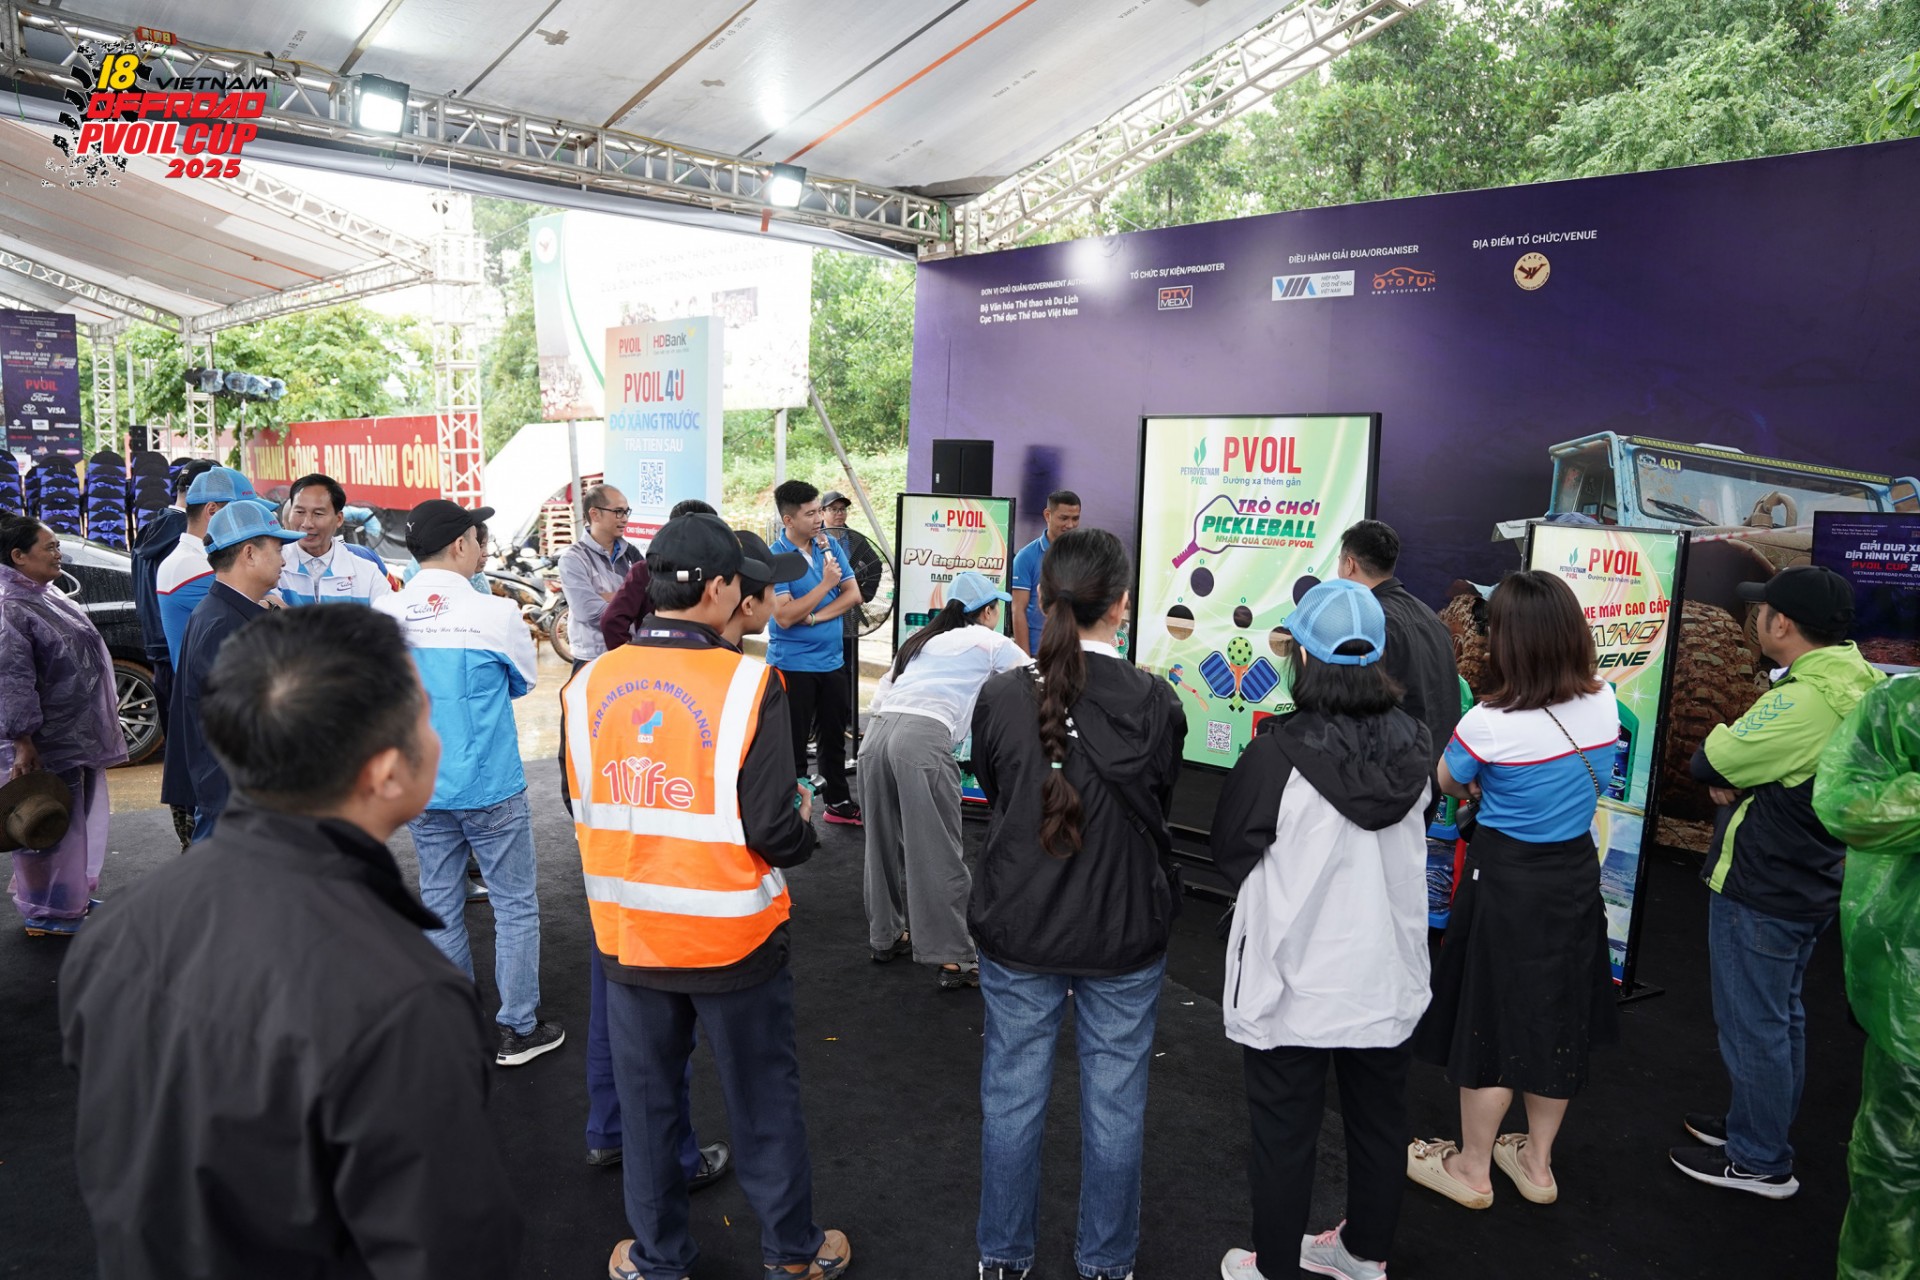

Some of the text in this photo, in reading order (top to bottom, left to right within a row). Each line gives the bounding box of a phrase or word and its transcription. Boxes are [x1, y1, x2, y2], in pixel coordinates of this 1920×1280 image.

[1472, 230, 1598, 250] ĐỊA ĐIỂM TỔ CHỨC/VENUE
[1308, 251, 1331, 262] HÀNH
[1332, 248, 1349, 260] GIẢI
[1350, 244, 1419, 258] ĐUA/ORGANISER
[1170, 262, 1225, 276] KIỆN/PROMOTER
[980, 304, 989, 314] Bộ
[1028, 298, 1044, 308] thao
[1054, 296, 1063, 305] Du
[1064, 294, 1079, 306] Lịch
[1160, 298, 1190, 308] MEDIA
[1032, 310, 1047, 319] thao
[1062, 307, 1079, 317] Nam
[619, 337, 642, 353] PVOIL
[653, 333, 687, 348] HDBank
[26, 380, 58, 392] PVOIL
[30, 392, 55, 403] Ford
[46, 406, 66, 415] VISA
[254, 440, 287, 480] THÀNH
[348, 436, 399, 487] THÀNH
[1223, 436, 1302, 474] PVOIL
[1180, 466, 1220, 476] PETROVIETNAM
[1660, 457, 1681, 471] 407
[1190, 476, 1208, 485] PVOIL
[1222, 476, 1250, 486] Đường
[1286, 477, 1302, 488] gần
[1238, 496, 1321, 516] TRÒ CHƠI
[946, 510, 986, 528] PVOIL
[1202, 515, 1317, 539] PICKLEBALL
[1288, 540, 1314, 549] PVOIL
[1860, 540, 1881, 551] GIẢI
[904, 548, 1004, 570] PV Engine RMI
[1588, 548, 1642, 577] PVOIL
[1845, 550, 1918, 564] ĐỊA HÌNH VIỆT
[1852, 561, 1882, 570] PVOIL
[1886, 563, 1908, 571] CUP
[1600, 602, 1622, 618] MÁY
[1625, 602, 1646, 616] CAO
[1650, 596, 1671, 614] CẤP
[592, 679, 713, 749] PARAMEDIC AMBULANCE
